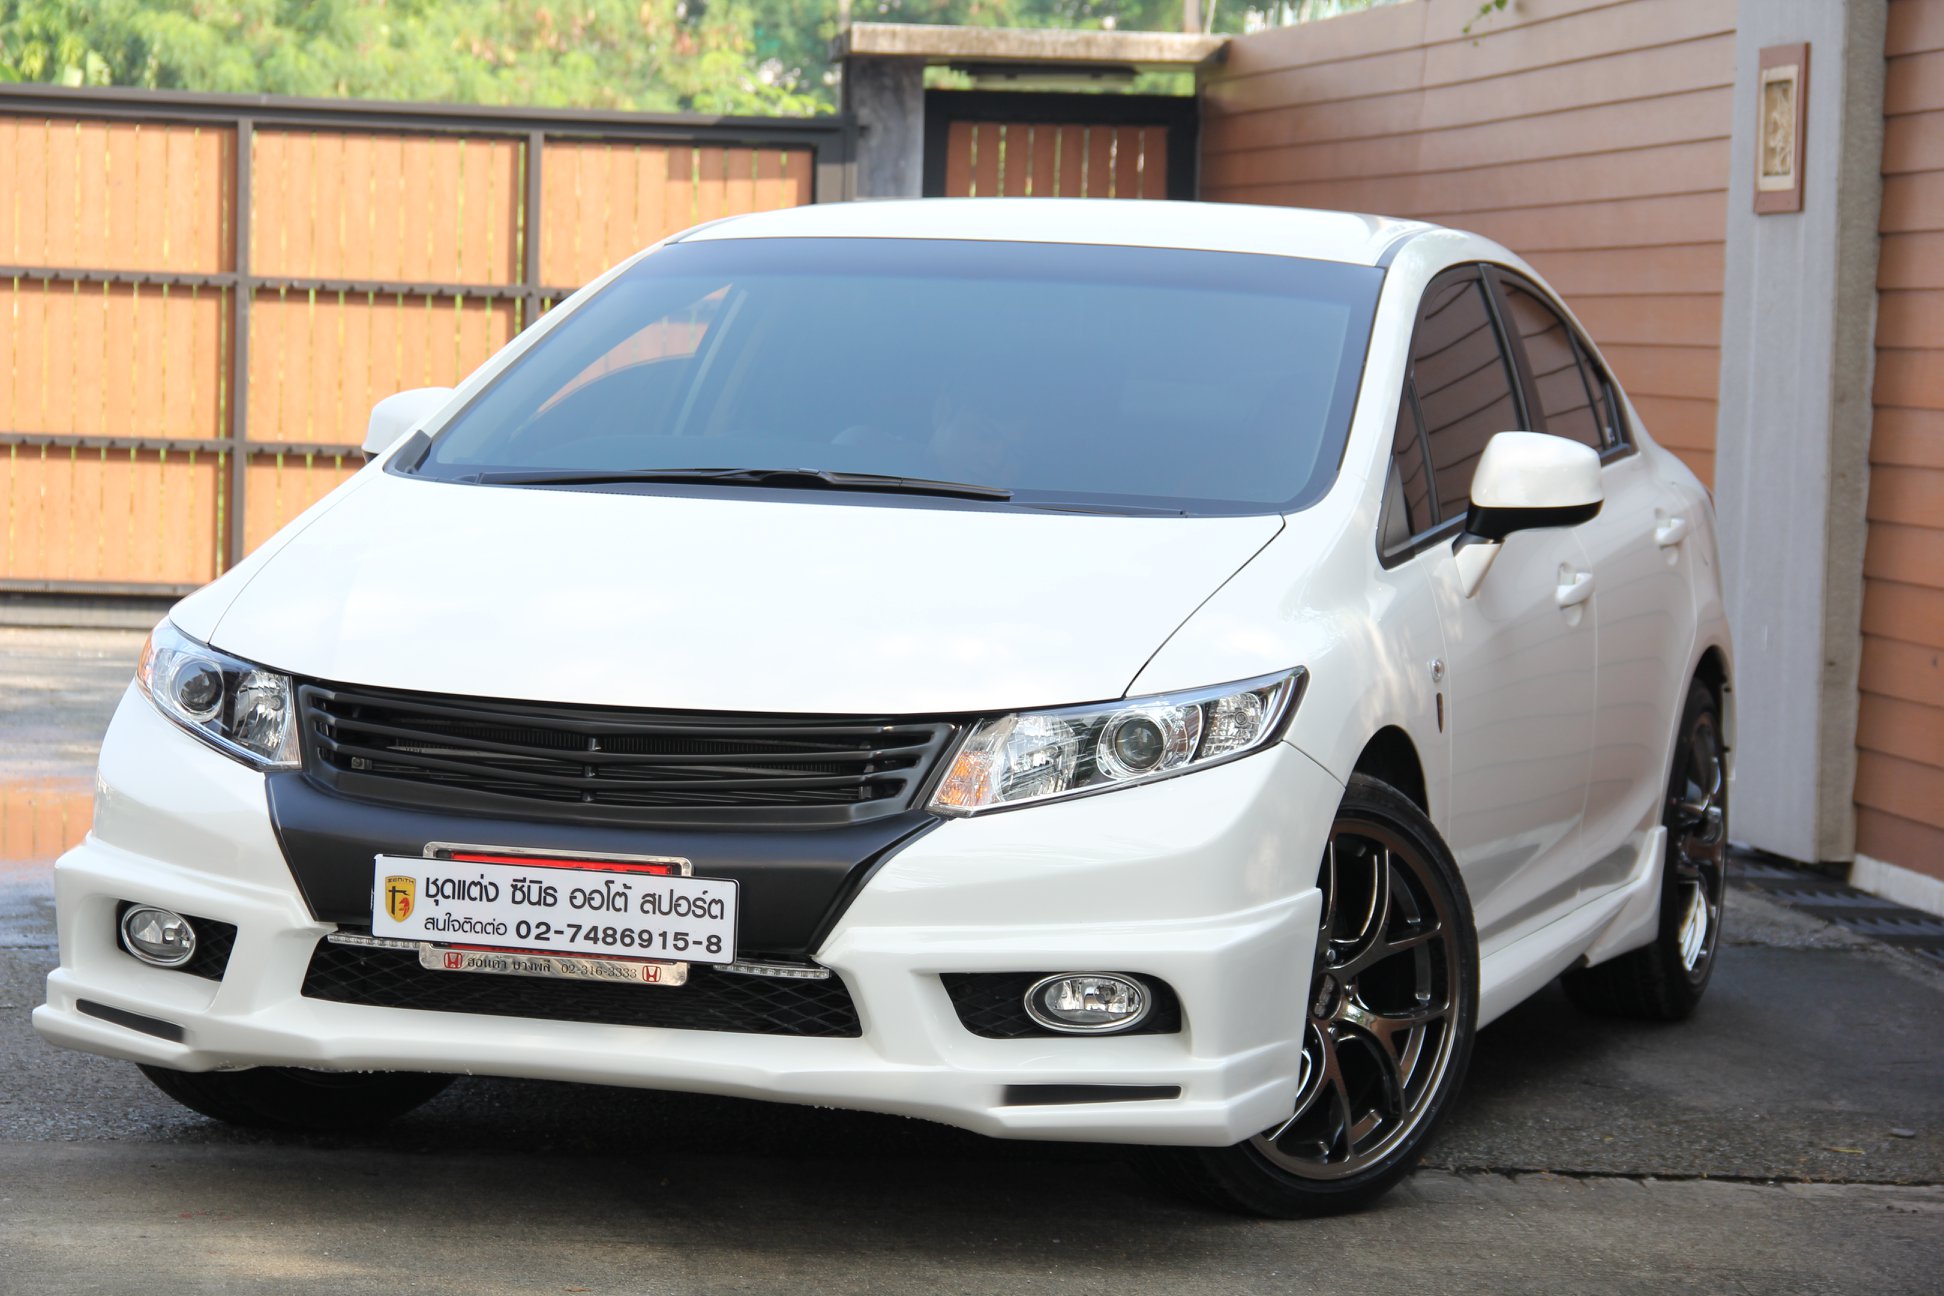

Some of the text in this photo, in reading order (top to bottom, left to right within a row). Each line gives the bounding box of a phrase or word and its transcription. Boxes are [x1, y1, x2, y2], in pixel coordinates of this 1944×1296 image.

[425, 873, 725, 920] ชุดแต่ง ซีนิธ ออโต้ สปอร์ต
[424, 912, 723, 954] สนใจติดต่อ 02-7486915-8
[561, 963, 638, 979] 02-316-3333
